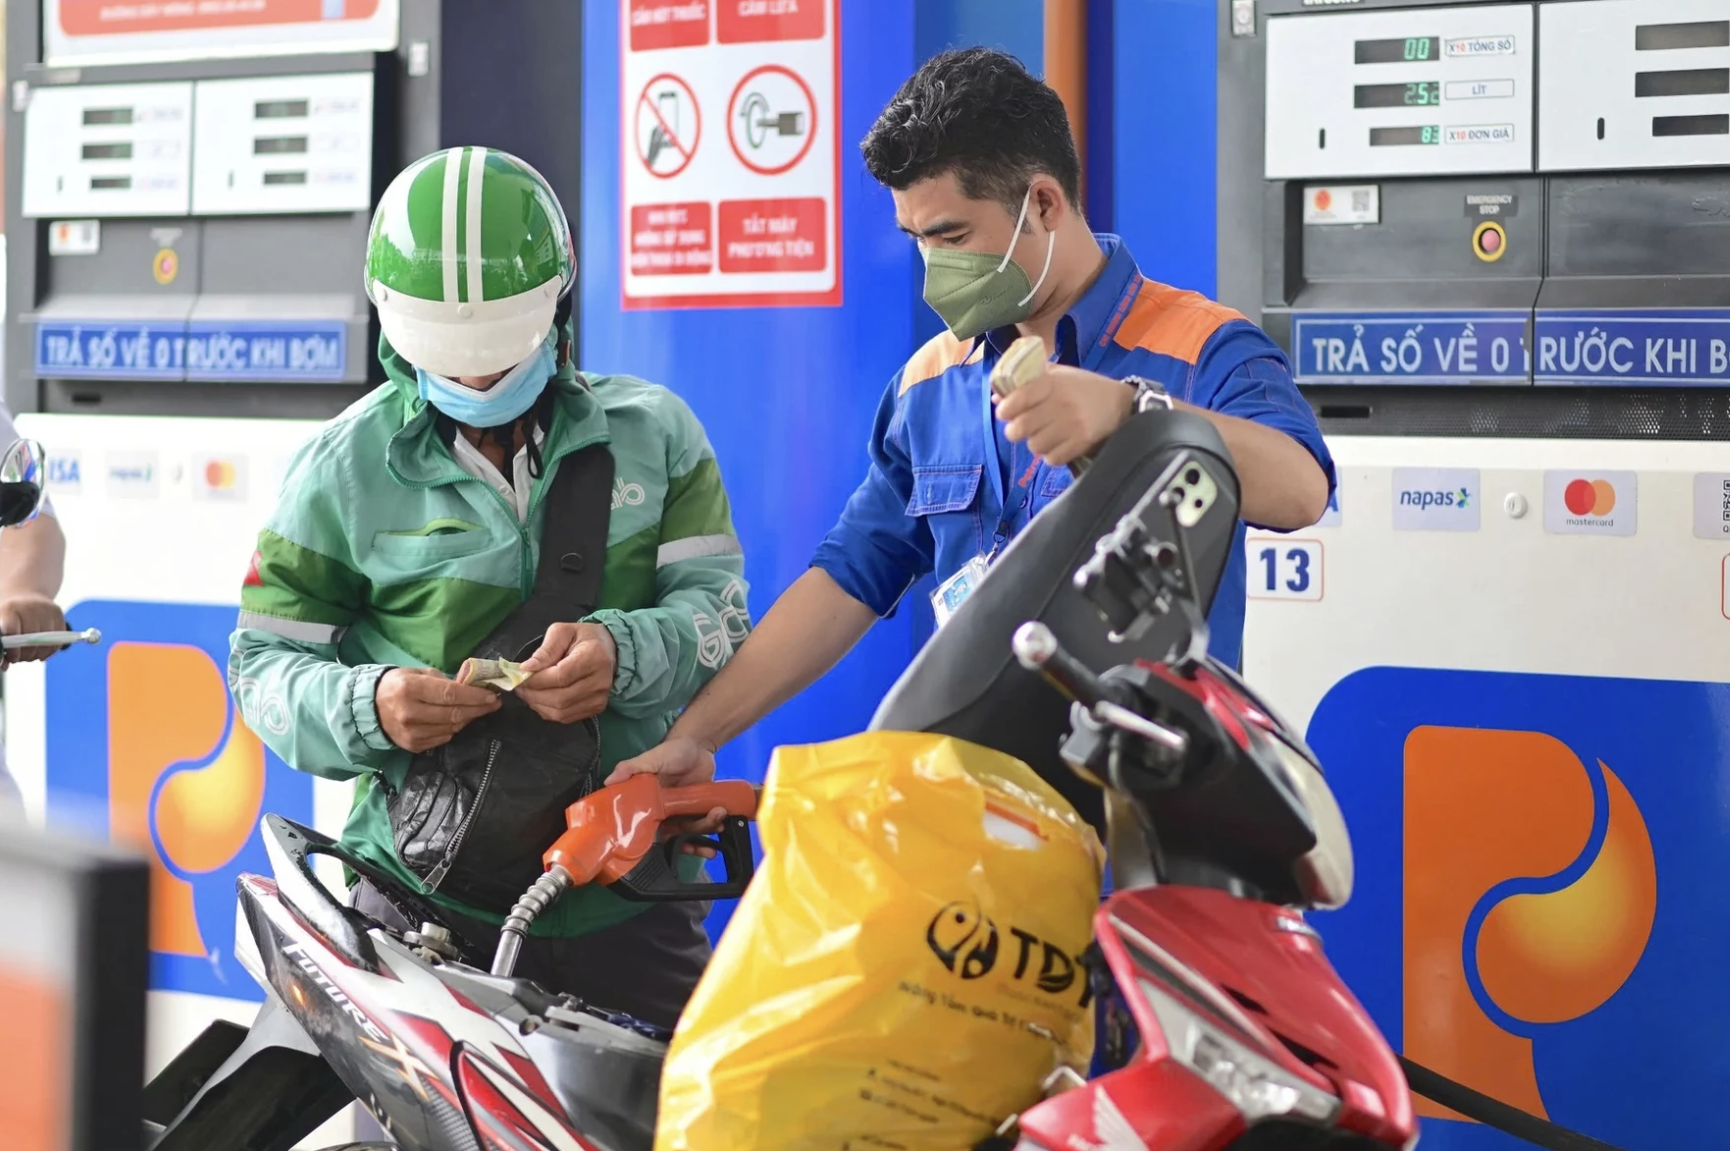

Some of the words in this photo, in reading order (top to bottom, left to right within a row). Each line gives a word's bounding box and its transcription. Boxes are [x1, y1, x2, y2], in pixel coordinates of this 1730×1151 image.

[1472, 84, 1487, 95] LÍT
[1479, 204, 1500, 215] STOP
[47, 325, 84, 365] TRẢ
[88, 325, 118, 367] SỐ
[121, 326, 151, 366] VỀ
[251, 337, 286, 367] KHI
[291, 334, 338, 369] BƠM
[1312, 324, 1370, 373] TRẢ
[1380, 324, 1424, 371] SỐ
[1434, 322, 1478, 373] VỀ
[1490, 337, 1510, 373] 0
[1645, 338, 1697, 374] KHI
[49, 458, 81, 482] ISA
[1400, 488, 1455, 511] napas
[1566, 518, 1614, 527] mastercard
[1259, 547, 1310, 592] 13
[282, 944, 390, 1042] FUTURE
